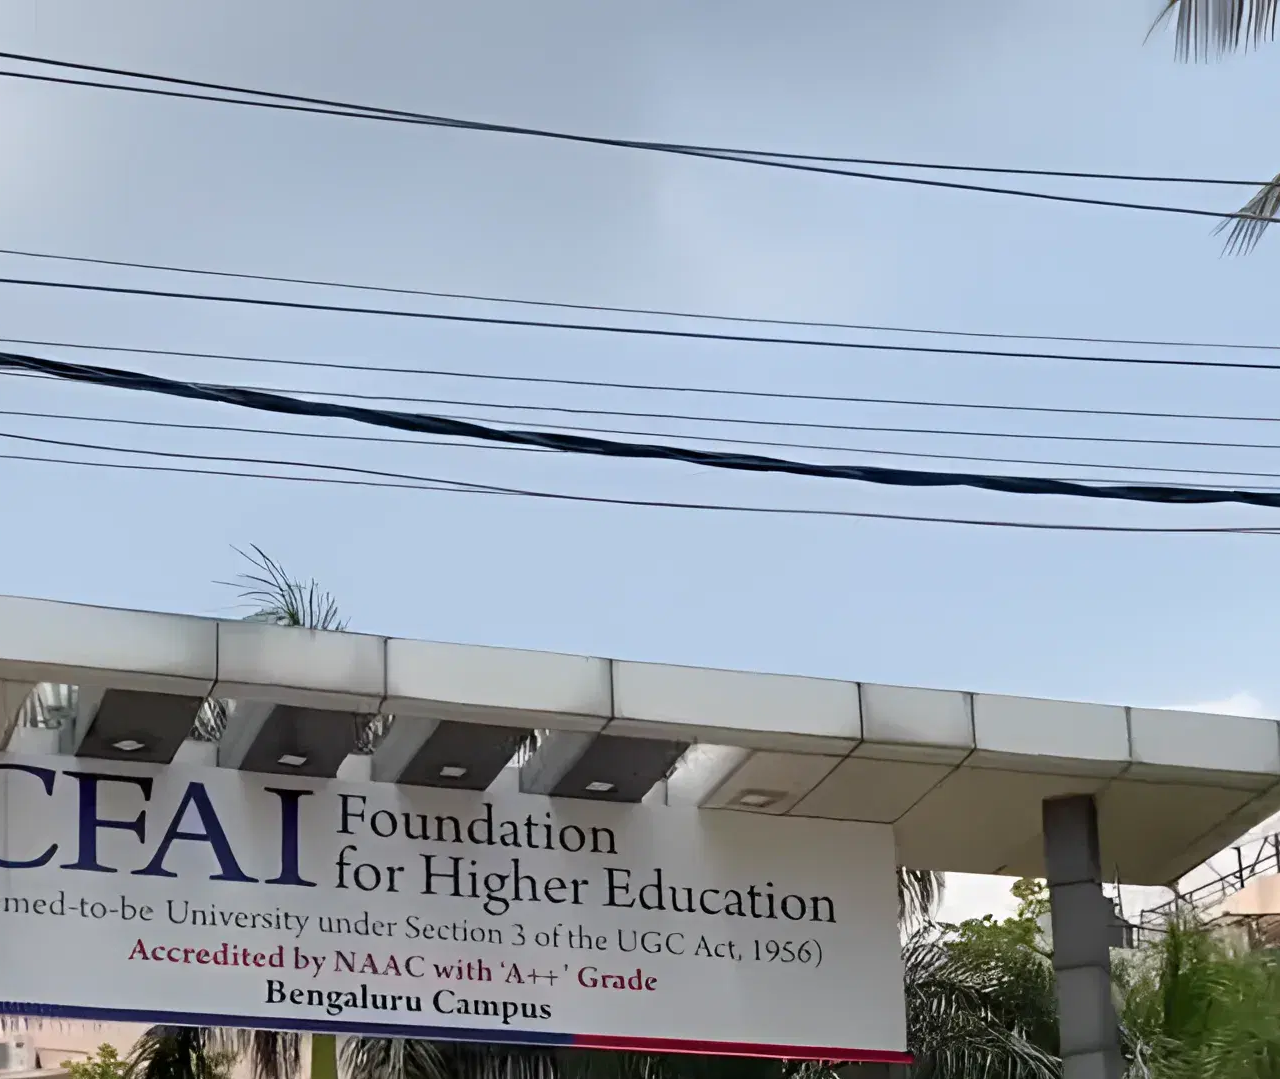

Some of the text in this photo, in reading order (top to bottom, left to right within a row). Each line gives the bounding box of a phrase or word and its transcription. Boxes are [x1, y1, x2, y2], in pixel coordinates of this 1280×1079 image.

[336, 793, 618, 854] Foundation
[335, 845, 837, 924] for Higher Education
[167, 900, 310, 938] University
[318, 909, 397, 938] under
[405, 914, 502, 945] Section
[511, 924, 526, 946] 3
[534, 922, 565, 949] of
[567, 925, 608, 951] the
[618, 930, 686, 957] UGC
[694, 938, 743, 962] Act,
[753, 938, 823, 968] 1956)
[128, 938, 284, 970] Accredited
[293, 946, 326, 978] by
[333, 950, 425, 978] NAAC
[432, 957, 492, 982] with
[577, 966, 658, 992] Grade
[265, 978, 552, 1025] Bengaluru Campus
